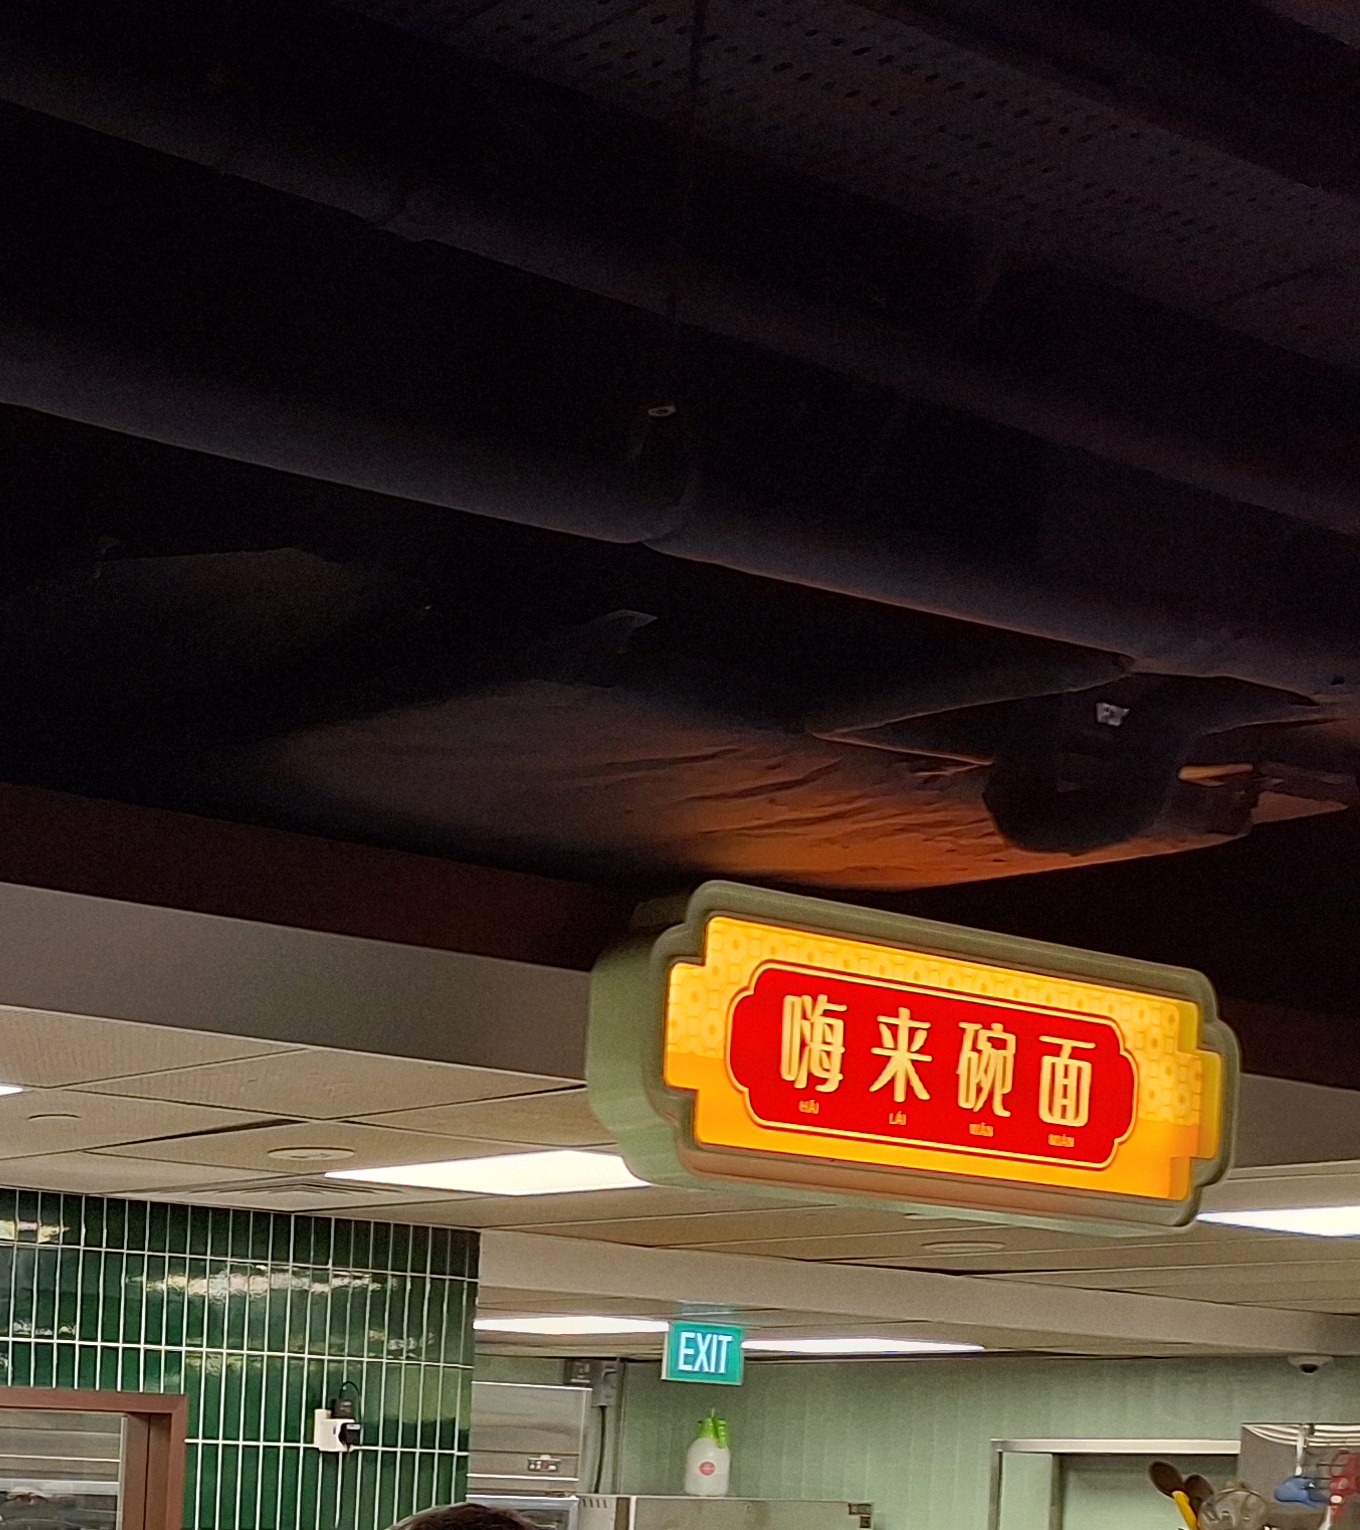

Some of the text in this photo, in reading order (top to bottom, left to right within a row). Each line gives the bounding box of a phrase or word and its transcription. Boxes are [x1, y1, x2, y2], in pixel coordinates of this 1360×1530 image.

[780, 994, 1096, 1127] 嗨来碗面
[678, 1330, 733, 1375] EXIT
